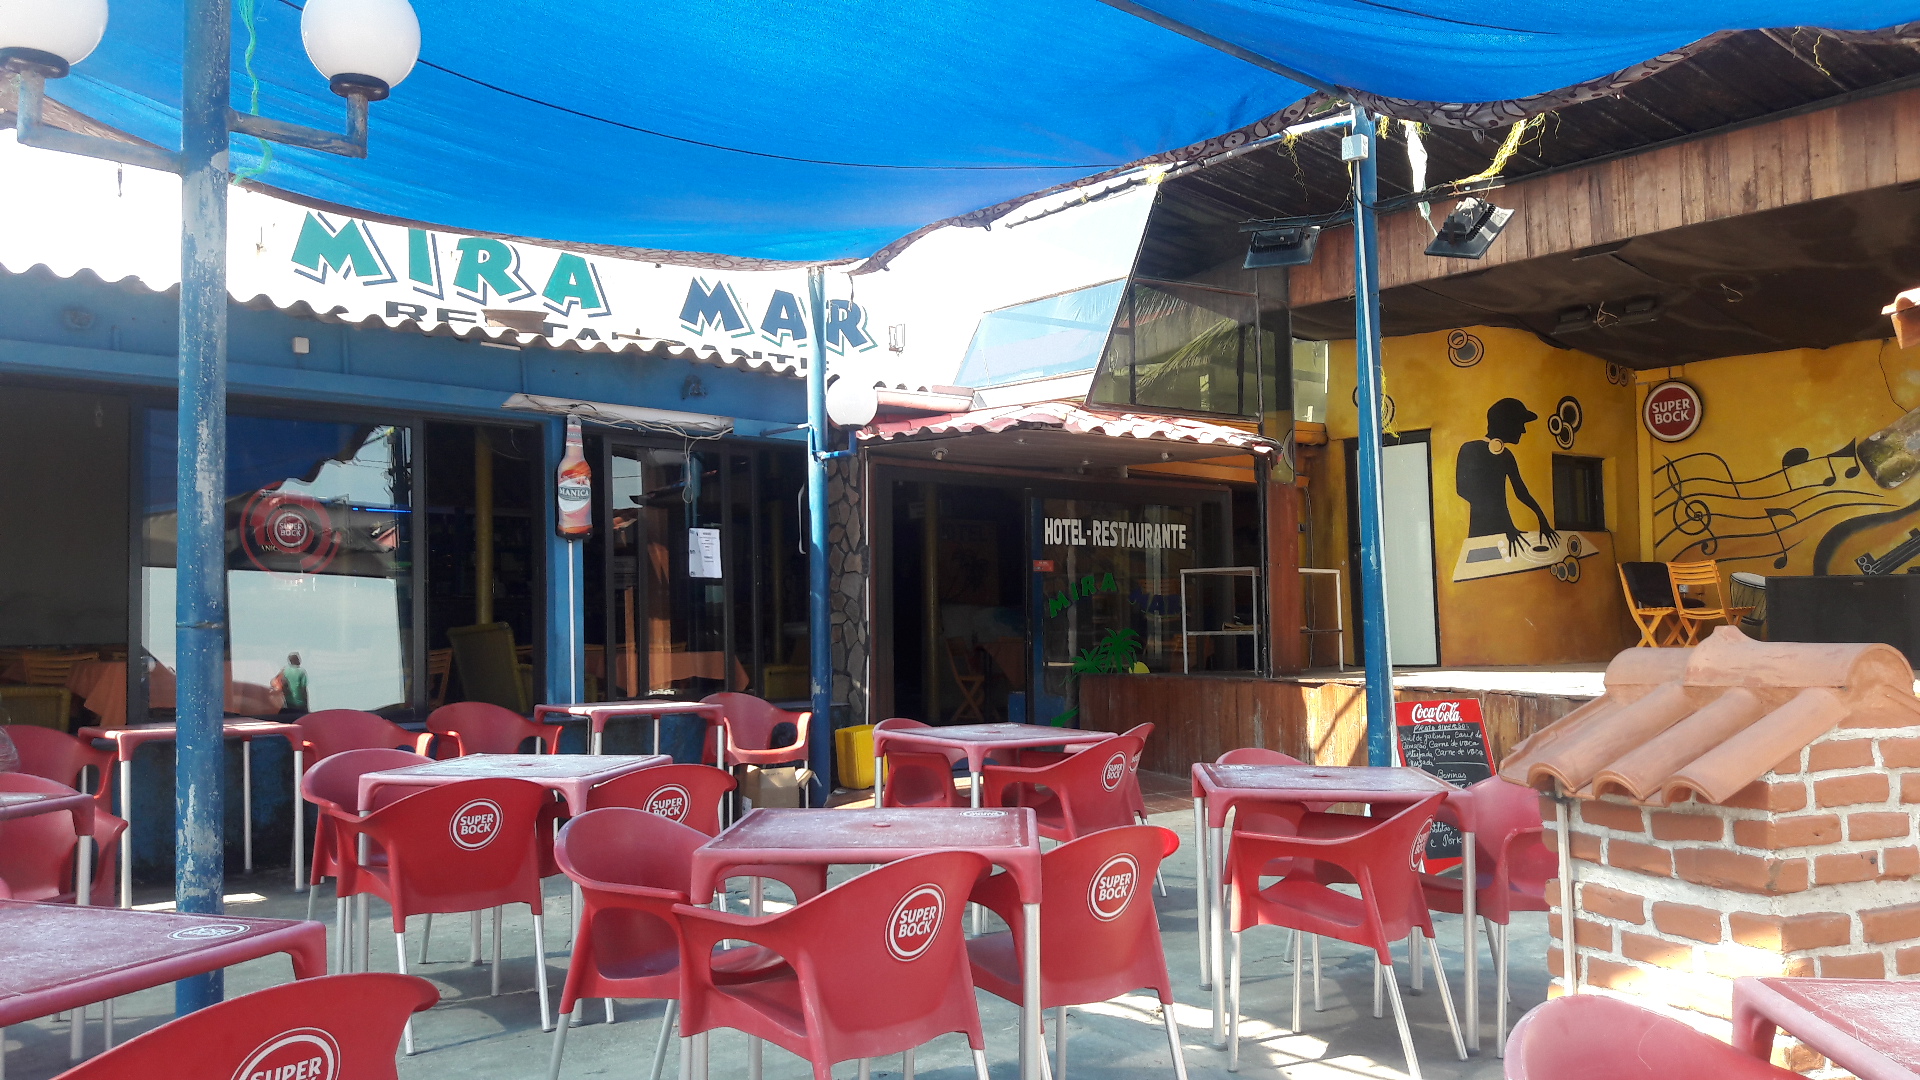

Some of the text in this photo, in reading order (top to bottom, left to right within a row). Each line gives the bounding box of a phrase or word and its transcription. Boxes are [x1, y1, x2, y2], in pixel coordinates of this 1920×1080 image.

[291, 211, 878, 356] MIRA MAR
[1652, 398, 1690, 414] SUPER
[1654, 410, 1690, 425] BOCK
[279, 522, 302, 530] SUPER
[280, 529, 302, 537] BOCK
[1044, 517, 1187, 550] HOTEL-RESTAURANTE
[1048, 572, 1118, 619] MIRA
[1411, 702, 1461, 723] Coca-Cola
[652, 797, 682, 810] SUPER
[653, 806, 681, 817] BOCK
[460, 813, 494, 826] SUPER
[461, 823, 492, 835] BOCK
[1098, 872, 1132, 890] SUPER
[1098, 884, 1129, 902] BOCK
[899, 905, 937, 925] SUPER
[898, 920, 933, 939] BOCK
